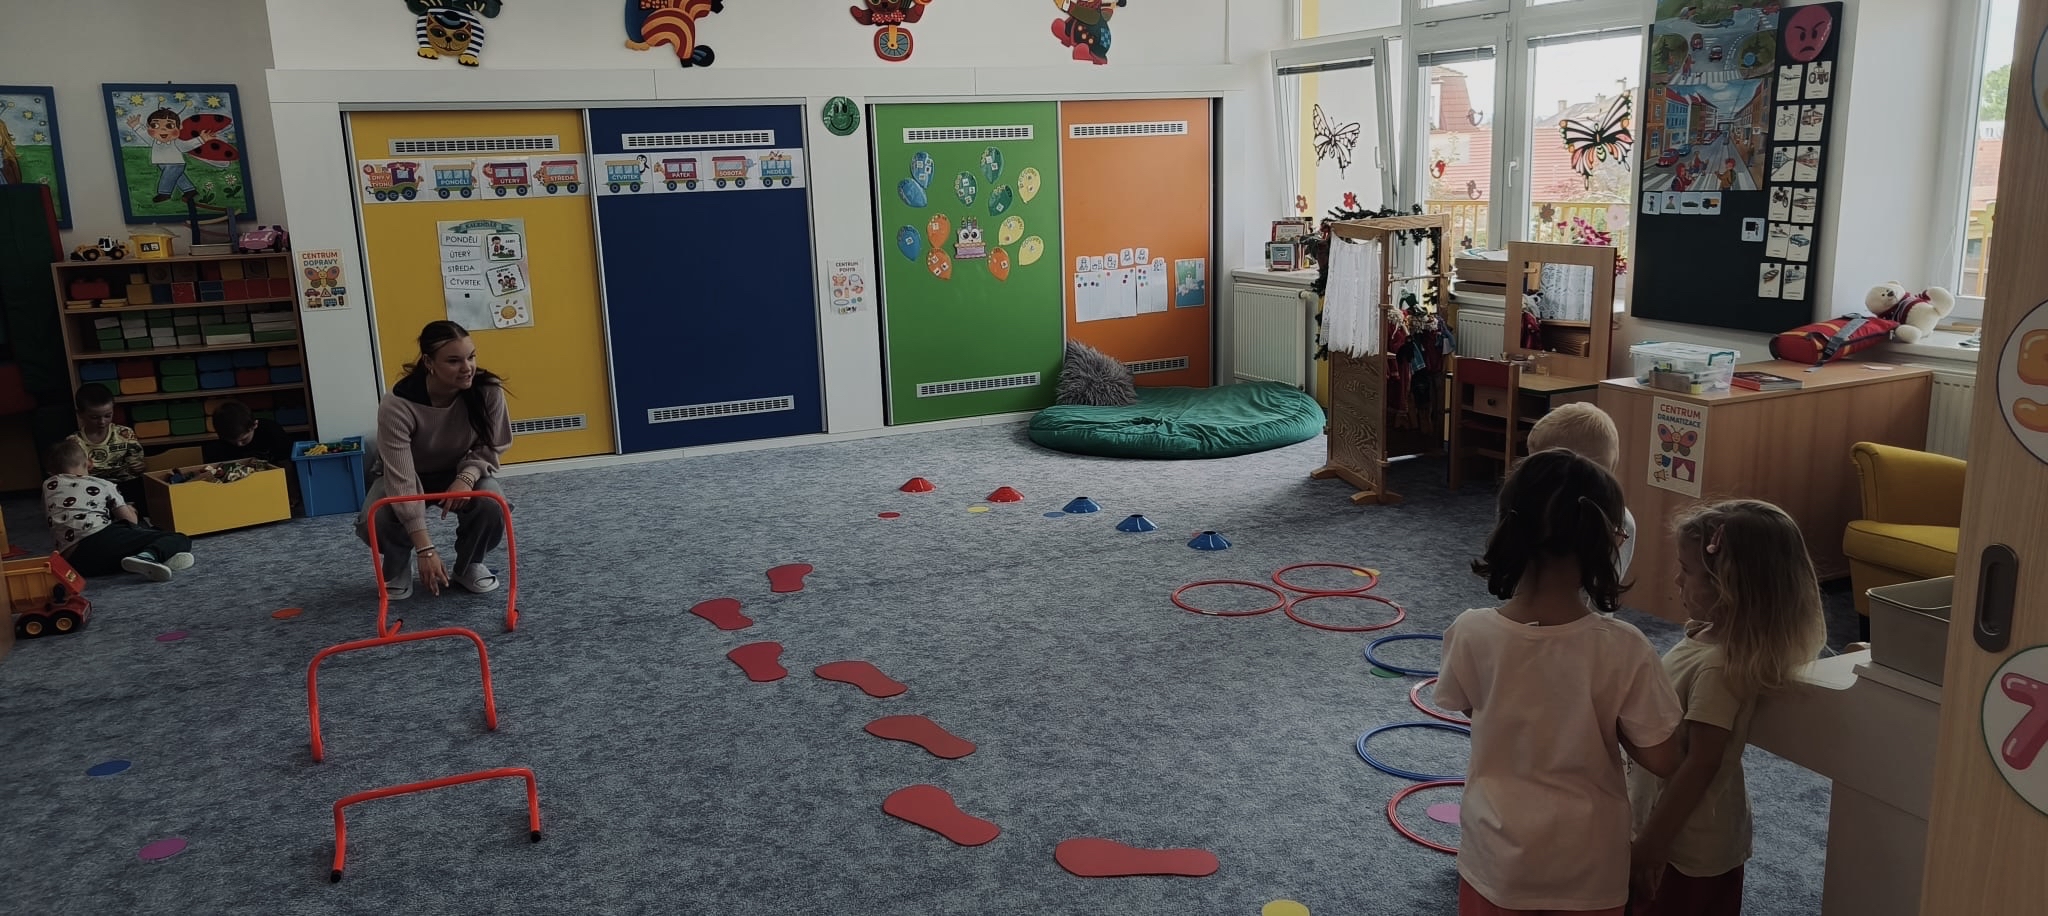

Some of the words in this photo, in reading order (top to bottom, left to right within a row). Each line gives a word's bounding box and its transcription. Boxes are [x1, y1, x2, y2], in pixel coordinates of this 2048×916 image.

[445, 235, 478, 243] PONDĚLÍ
[449, 249, 471, 258] ÚTERÝ
[447, 264, 475, 272] STŘEDA
[449, 277, 481, 286] ČTVRTEK
[1660, 404, 1701, 419] CENTRUM
[1657, 413, 1701, 428] DRAMATIZACE
